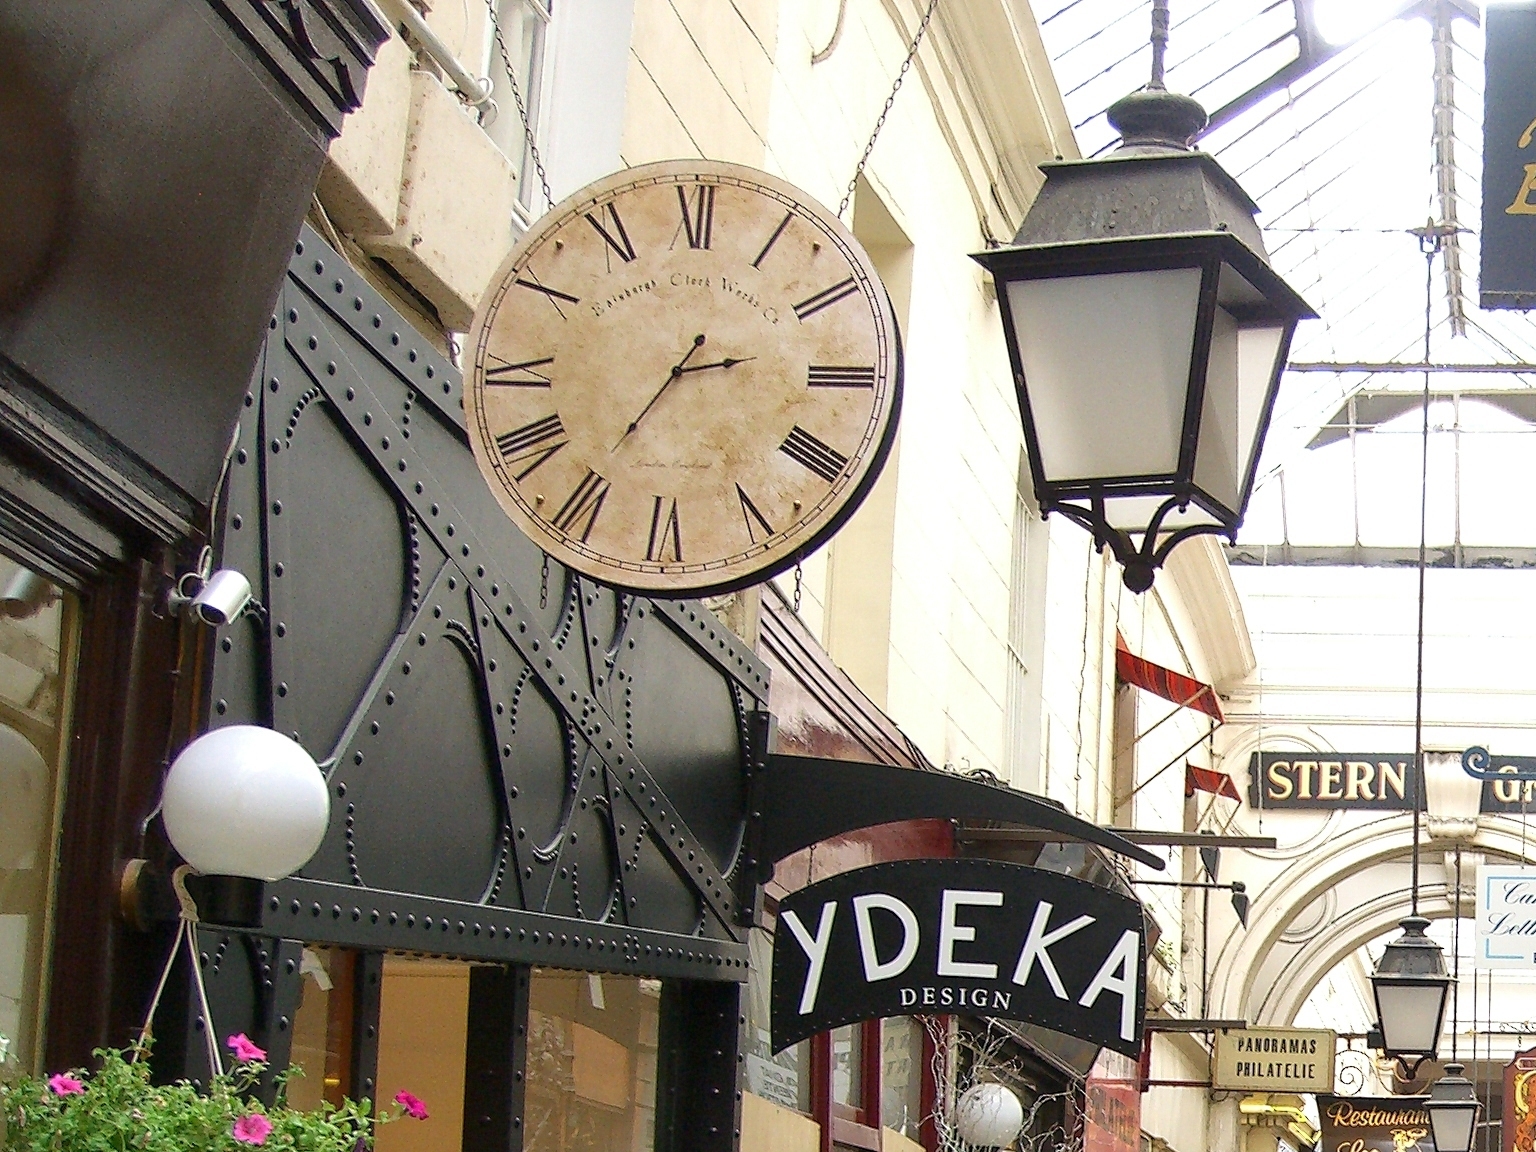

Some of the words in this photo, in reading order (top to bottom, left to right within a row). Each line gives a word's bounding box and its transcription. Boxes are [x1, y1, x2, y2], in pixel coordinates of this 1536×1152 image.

[1266, 760, 1407, 802] STERN
[780, 889, 1140, 1043] YDEKA
[899, 987, 1012, 1010] DESIGN
[1237, 1036, 1317, 1055] PANORAMAS
[1236, 1062, 1316, 1079] PHILATELIE
[1327, 1102, 1431, 1127] Restauran
